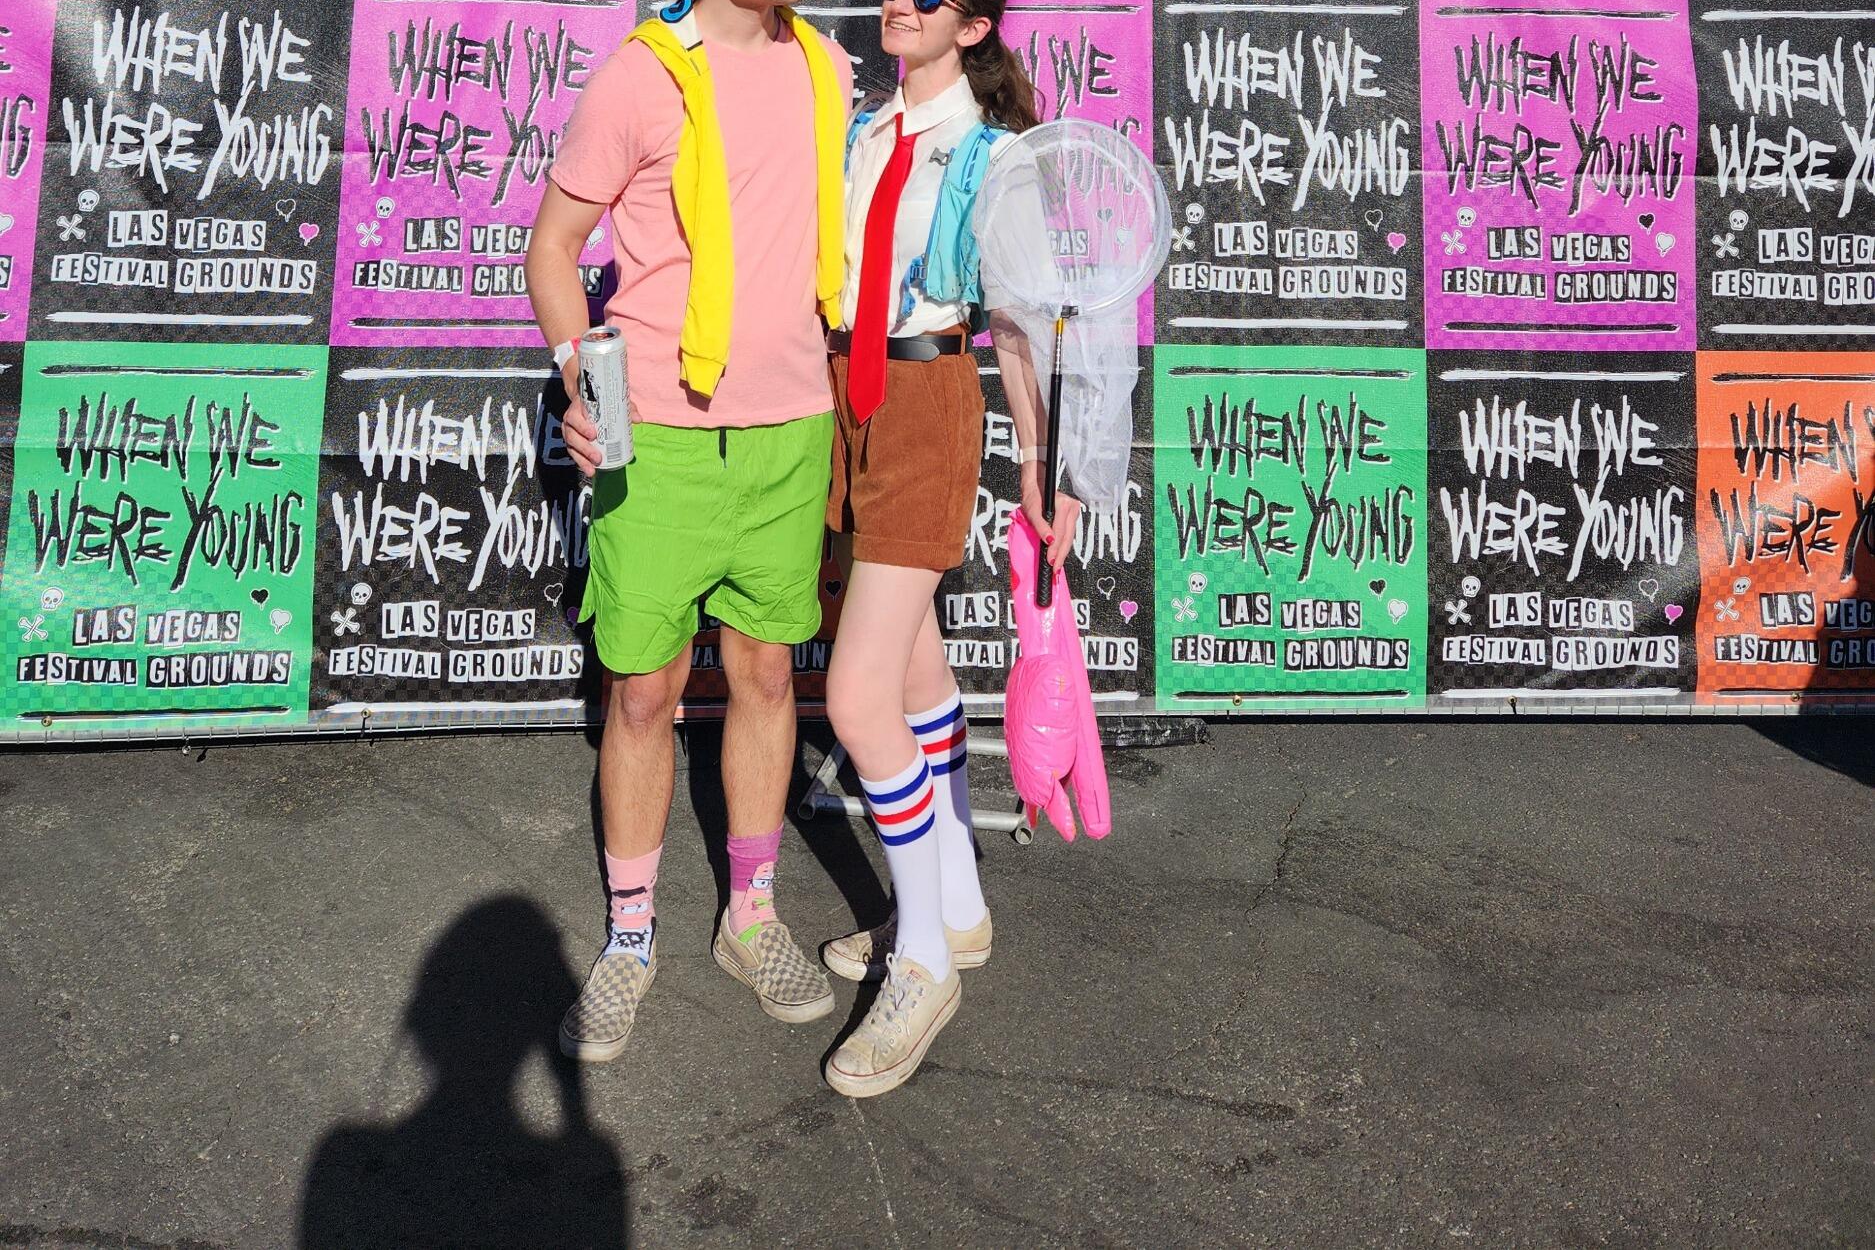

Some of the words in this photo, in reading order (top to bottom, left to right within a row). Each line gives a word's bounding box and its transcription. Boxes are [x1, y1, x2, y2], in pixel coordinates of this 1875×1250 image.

[94, 8, 228, 94] WHEN
[240, 11, 313, 96] WE
[390, 18, 514, 102] WHEN
[526, 21, 594, 101] WE
[1050, 27, 1120, 107] WE
[1185, 30, 1303, 111] WHEN
[1315, 29, 1386, 111] WE
[1457, 33, 1579, 115] WHEN
[1591, 34, 1664, 113] WE
[1725, 37, 1845, 118] WHEN
[64, 93, 203, 194] WERE
[199, 82, 333, 200] YOUNG
[362, 102, 493, 202] WERE
[1167, 111, 1293, 206] WERE
[1294, 99, 1410, 211] YOUNG
[1438, 115, 1567, 212] WERE
[1569, 103, 1686, 218] YOUNG
[1712, 117, 1837, 213] WERE
[109, 212, 166, 246] LAS
[176, 219, 264, 251] VEGAS
[406, 219, 460, 252] LAS
[472, 226, 529, 256] VEG
[1051, 232, 1087, 256] GAS
[1216, 223, 1266, 256] LAS
[1277, 229, 1356, 259] VEGAS
[1489, 229, 1540, 259] LAS
[1553, 234, 1629, 264] VEGAS
[1760, 229, 1811, 263] LAS
[1823, 234, 1875, 266] VEG
[53, 254, 167, 287] FESTIVAL
[176, 260, 314, 293] GROUNDS
[355, 262, 462, 291] FESTIVAL
[1171, 264, 1270, 293] FESTIVAL
[1281, 268, 1404, 299] GROUNDS
[1443, 268, 1545, 297] FESTIVAL
[1556, 272, 1676, 303] GROUNDS
[1714, 271, 1815, 300] FESTIVAL
[58, 394, 196, 484] WHEN
[208, 394, 282, 481] WE
[361, 397, 492, 484] WHEN
[1188, 394, 1307, 479] WHEN
[1319, 393, 1391, 477] WE
[1461, 398, 1581, 481] WHEN
[1593, 397, 1663, 479] WE
[1733, 400, 1858, 485] WHEN
[30, 483, 174, 588] WERE
[172, 470, 304, 592] YOUNG
[334, 484, 472, 585] WERE
[470, 470, 592, 591] YOUNG
[1170, 477, 1298, 579] WERE
[1300, 464, 1415, 583] YOUNG
[1442, 481, 1568, 576] WERE
[1569, 466, 1684, 582] YOUNG
[1713, 483, 1841, 578] WERE
[74, 607, 136, 645] LAS
[146, 611, 239, 647] VEGAS
[384, 603, 437, 637] LAS
[450, 610, 534, 643] VEGAS
[948, 594, 998, 629] LAS
[1220, 594, 1270, 628] LAS
[1283, 600, 1359, 633] VEGAS
[1491, 593, 1539, 627] LAS
[1551, 599, 1632, 630] VEGAS
[1761, 593, 1814, 627] LAS
[1826, 600, 1875, 631] VEG
[331, 646, 439, 678] FESTIVAL
[451, 647, 582, 681] GROUNDS
[946, 641, 1002, 667] TIVAL
[1174, 636, 1274, 667] FESTIVAL
[1285, 638, 1407, 670] GROUNDS
[1445, 636, 1544, 664] FESTIVAL
[1554, 637, 1677, 670] GROUNDS
[1716, 635, 1818, 663] FESTIVAL
[19, 654, 136, 686] FESTIVAL
[148, 654, 290, 687] GROUNDS
